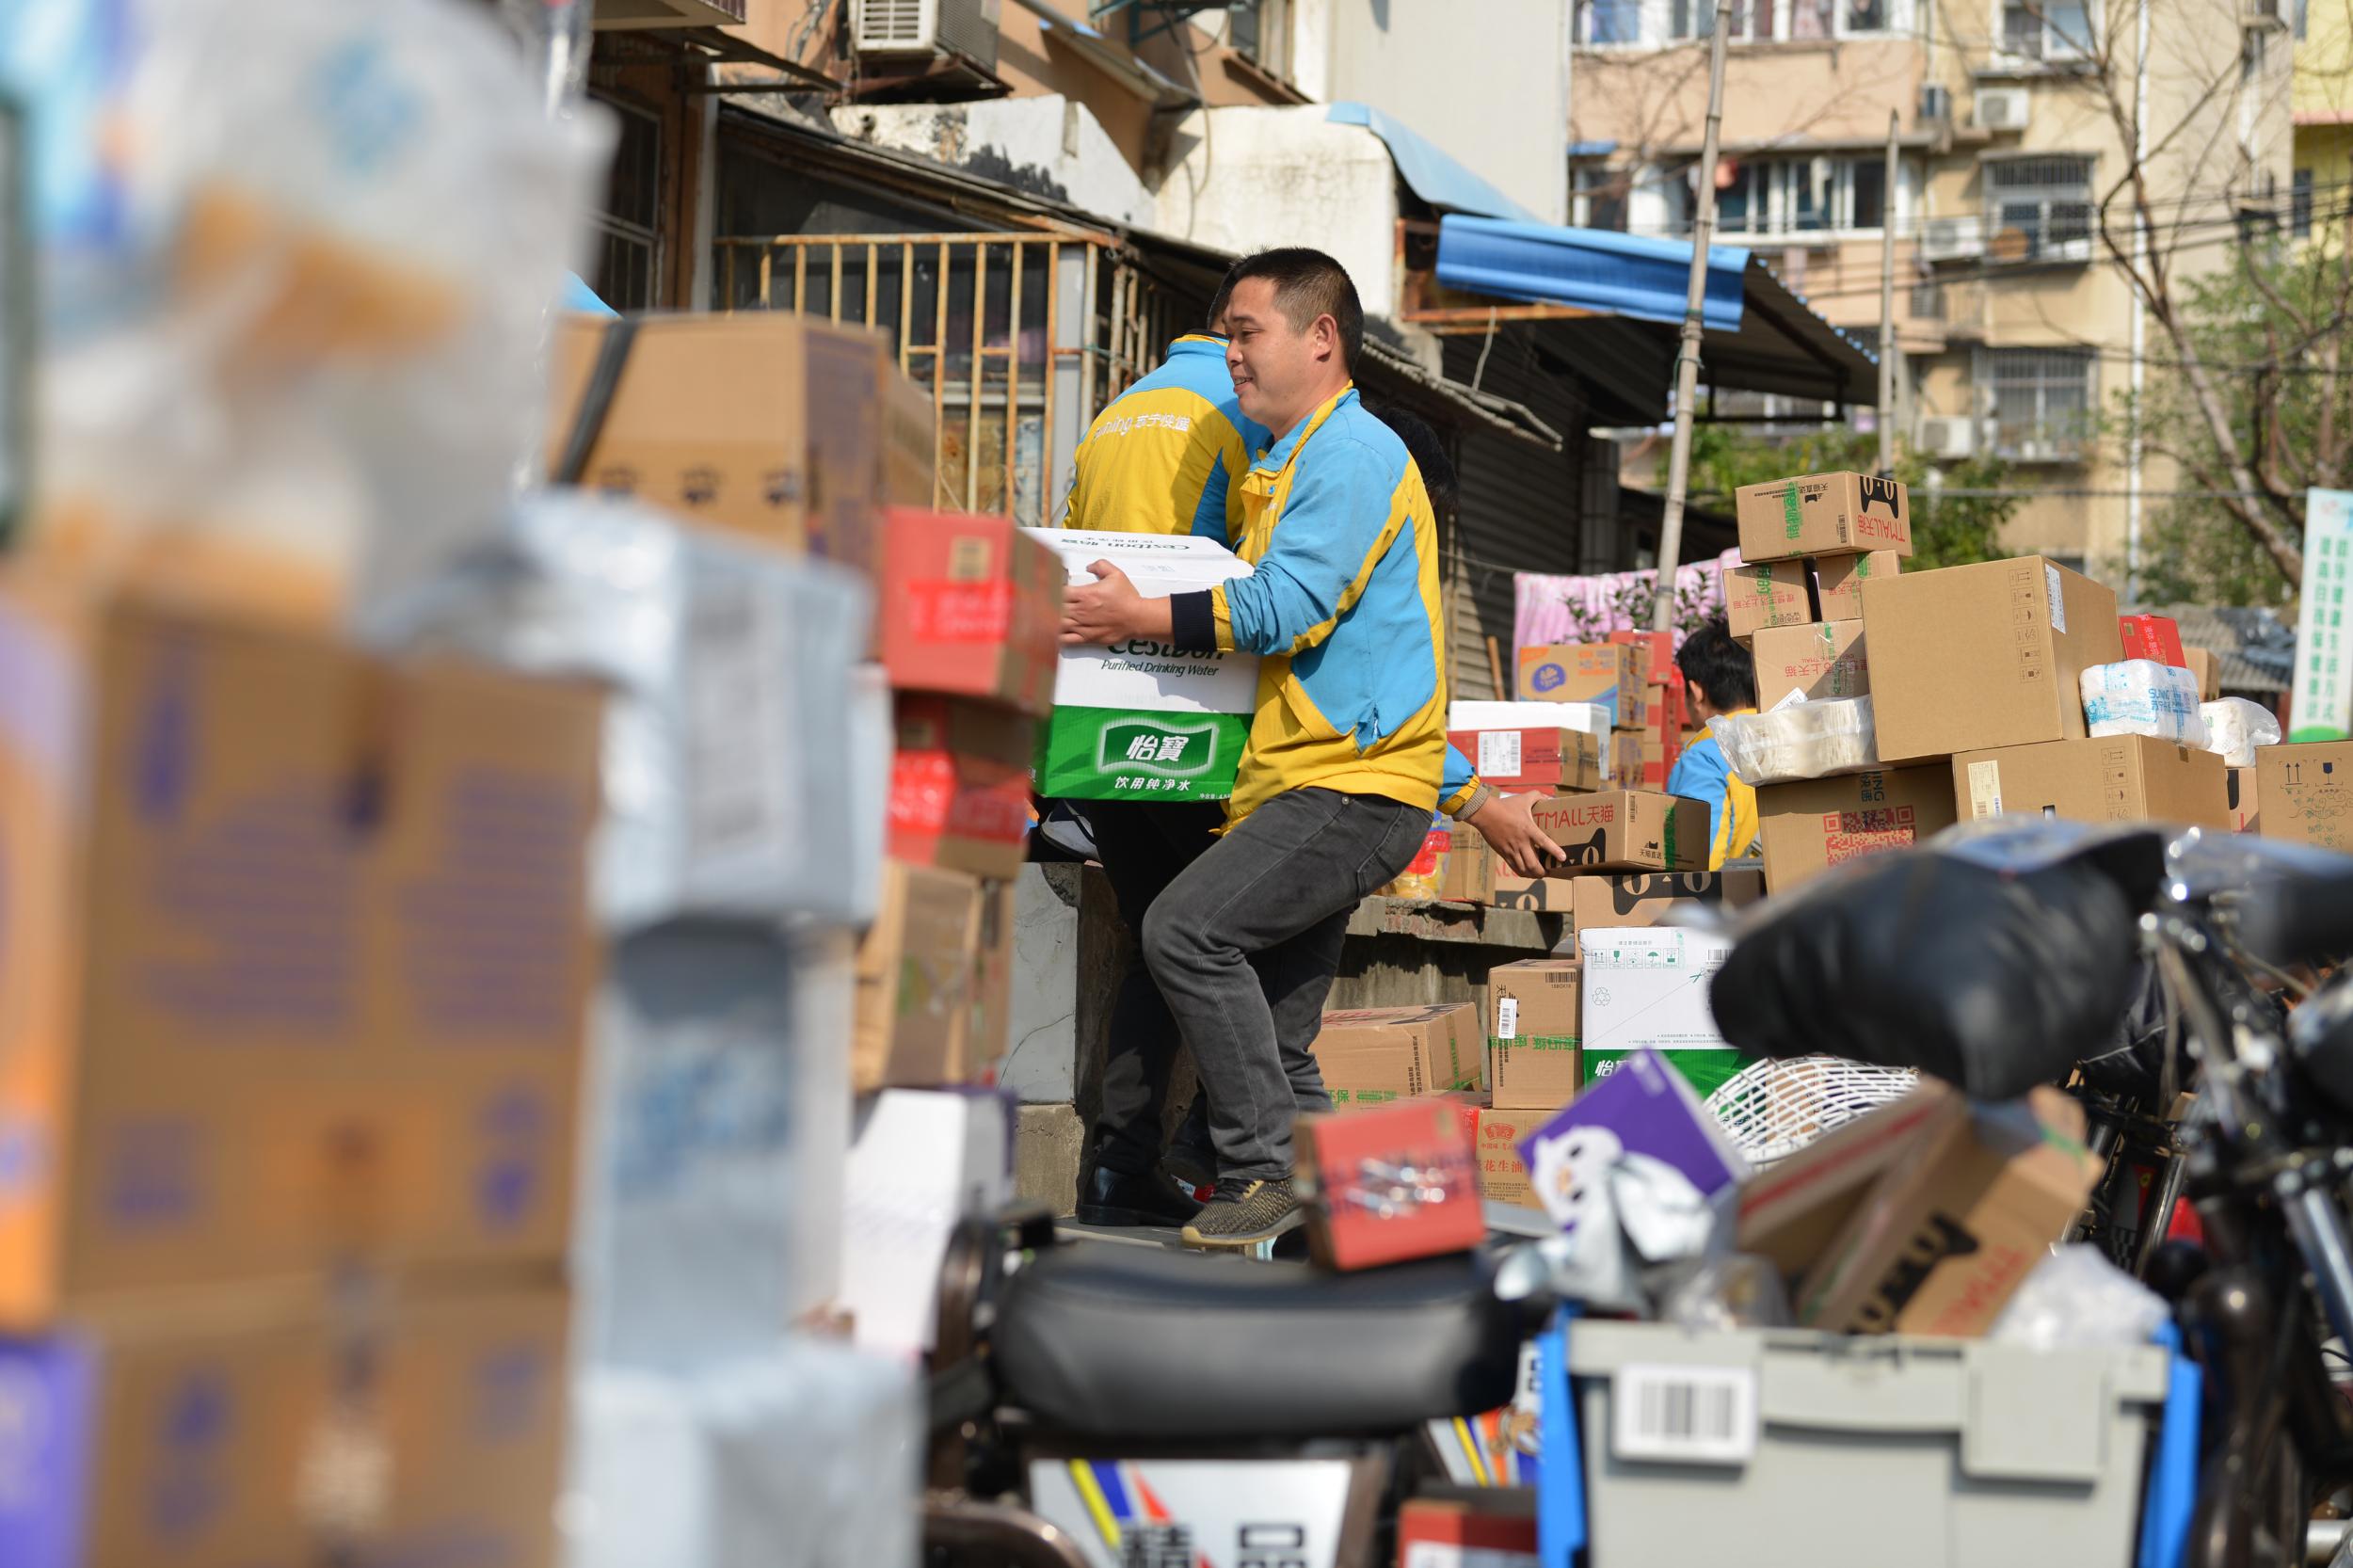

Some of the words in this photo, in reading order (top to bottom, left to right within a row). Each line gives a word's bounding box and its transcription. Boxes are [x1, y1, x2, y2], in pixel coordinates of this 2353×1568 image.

[1101, 659, 1143, 671] Purified
[1144, 662, 1185, 677] Drinking
[1188, 664, 1219, 676] Water
[1126, 734, 1189, 761] 怡寶
[1114, 776, 1191, 791] 饮用纯净水
[1533, 805, 1614, 830] TMALL天猫
[1476, 1159, 1523, 1173] 花生油
